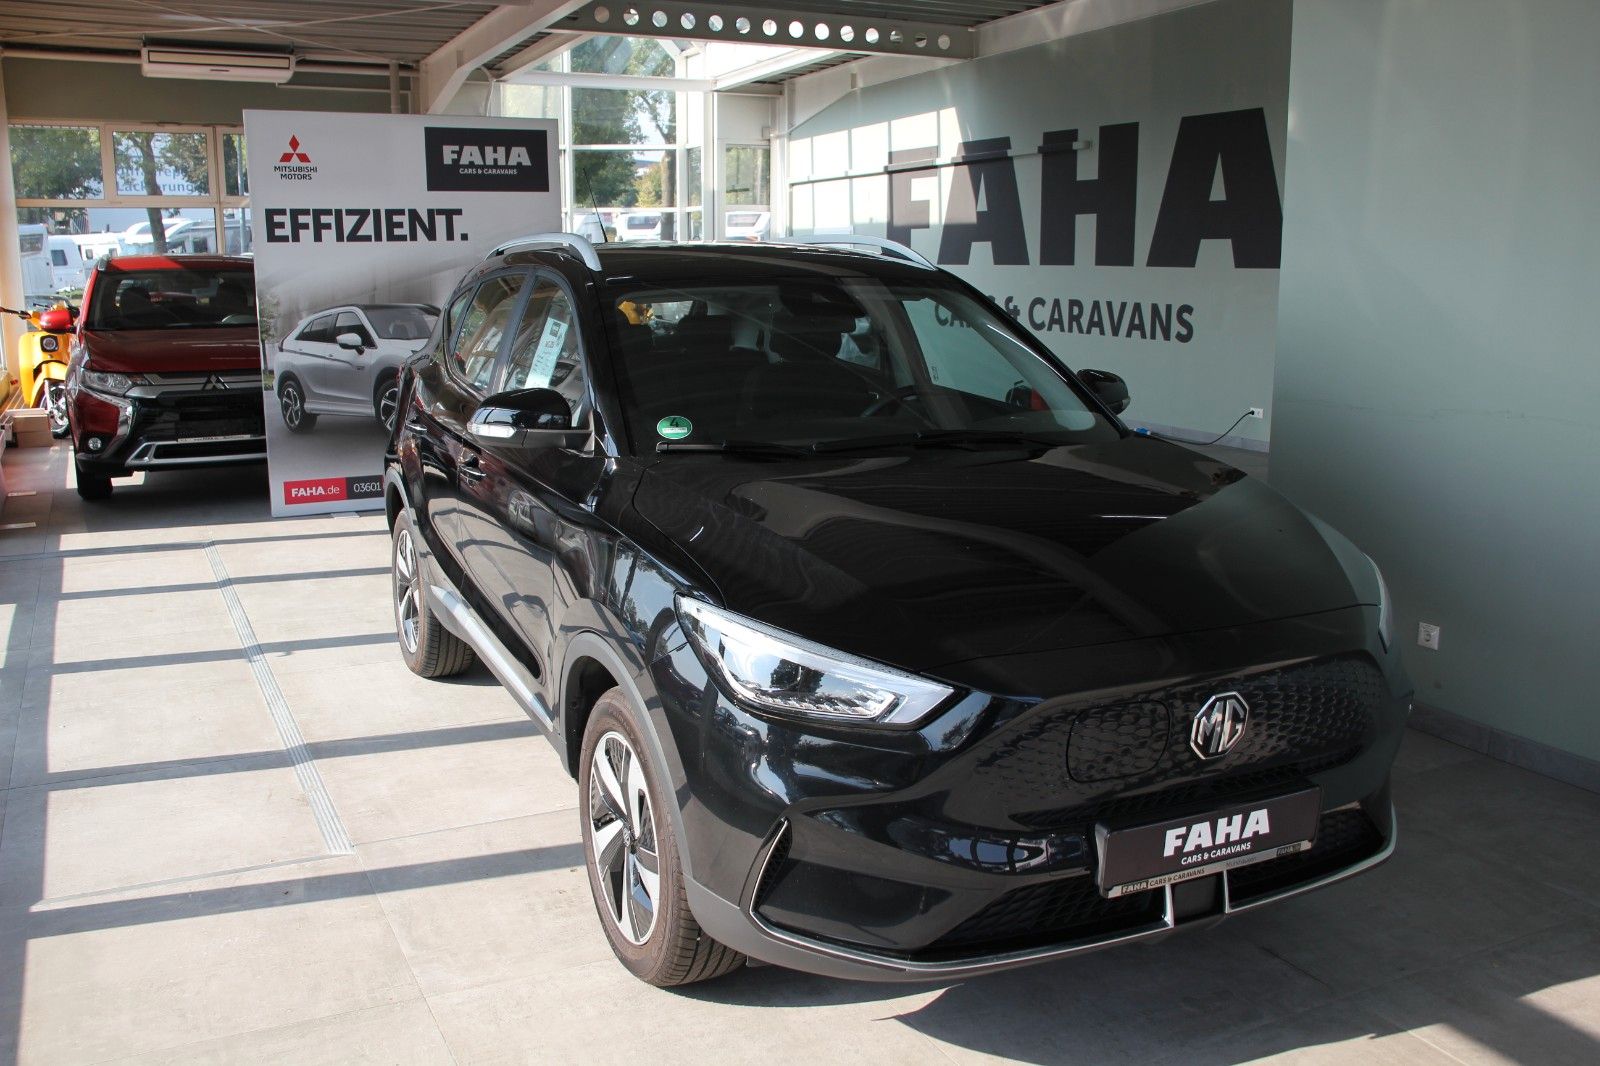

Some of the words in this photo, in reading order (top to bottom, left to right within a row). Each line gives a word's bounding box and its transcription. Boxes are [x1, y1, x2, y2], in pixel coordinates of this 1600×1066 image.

[442, 145, 532, 166] FAHA
[274, 165, 318, 173] MITSUBISHI
[887, 107, 1283, 269] FAHA
[264, 208, 469, 243] EFFIZIENT.
[1028, 296, 1195, 344] CARAVANS
[669, 416, 679, 428] 4
[291, 485, 340, 498] FAHA.de
[353, 482, 381, 492] 03601
[1197, 699, 1245, 753] MG
[1163, 808, 1270, 857] FAHA
[1181, 853, 1202, 865] CARS
[1210, 841, 1251, 858] CARAVANS
[1149, 876, 1167, 887] CARS
[1173, 867, 1205, 881] CARAVANS
